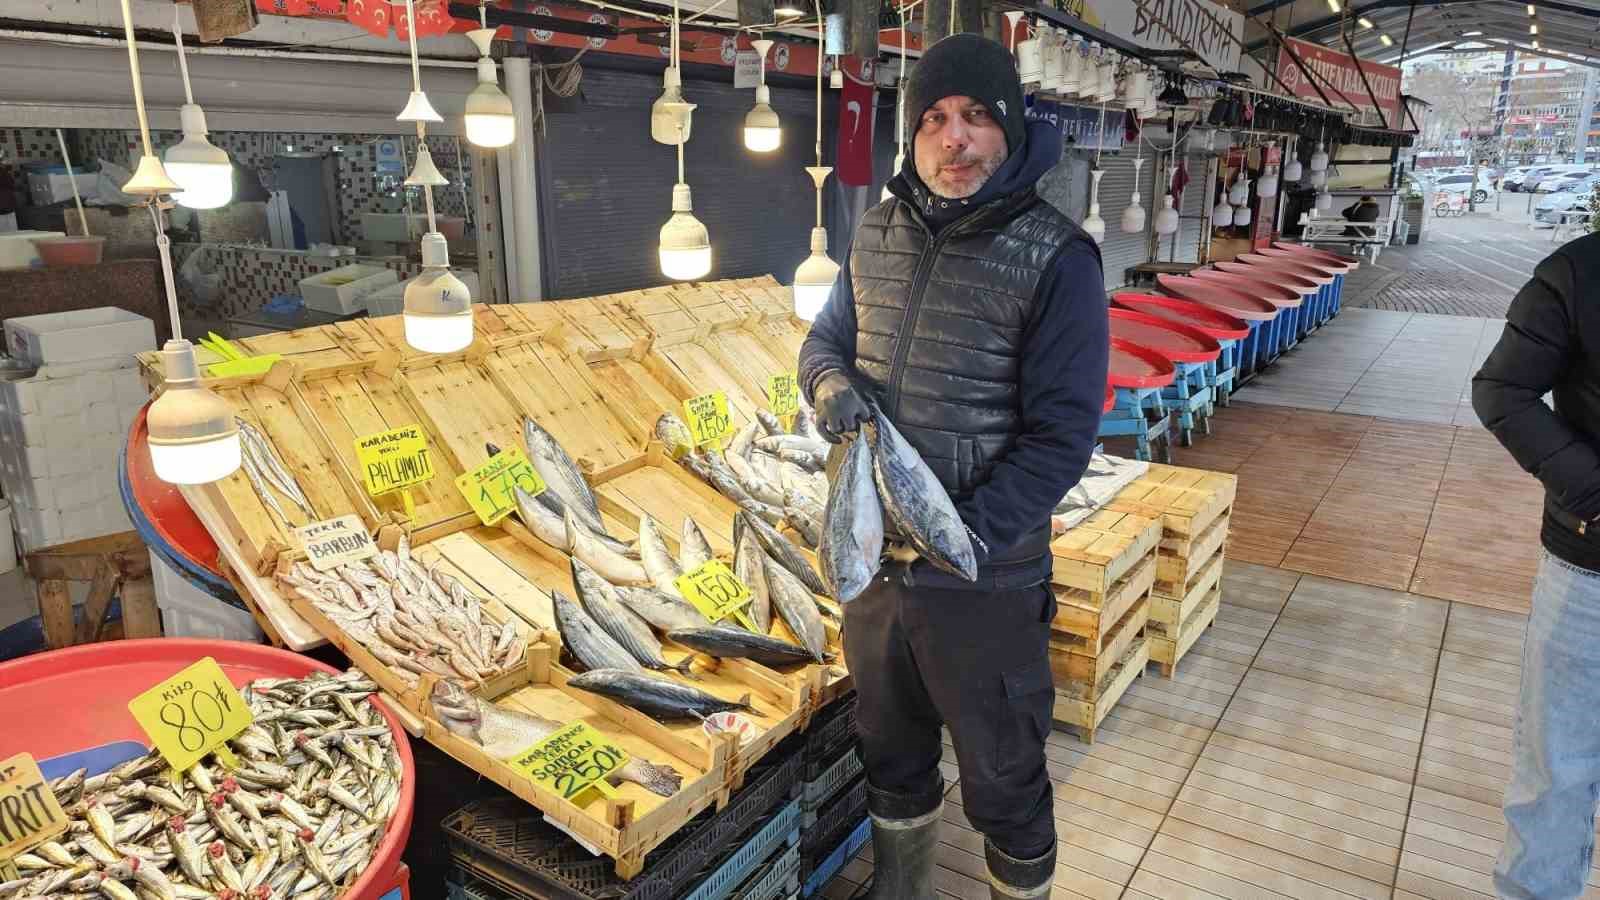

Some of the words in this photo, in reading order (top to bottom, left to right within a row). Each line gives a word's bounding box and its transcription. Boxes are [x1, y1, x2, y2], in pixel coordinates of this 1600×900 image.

[1132, 0, 1234, 62] BANDIRMA
[368, 449, 430, 488] PALAMUT
[308, 531, 370, 558] BARBUN
[532, 740, 593, 780] SOMON
